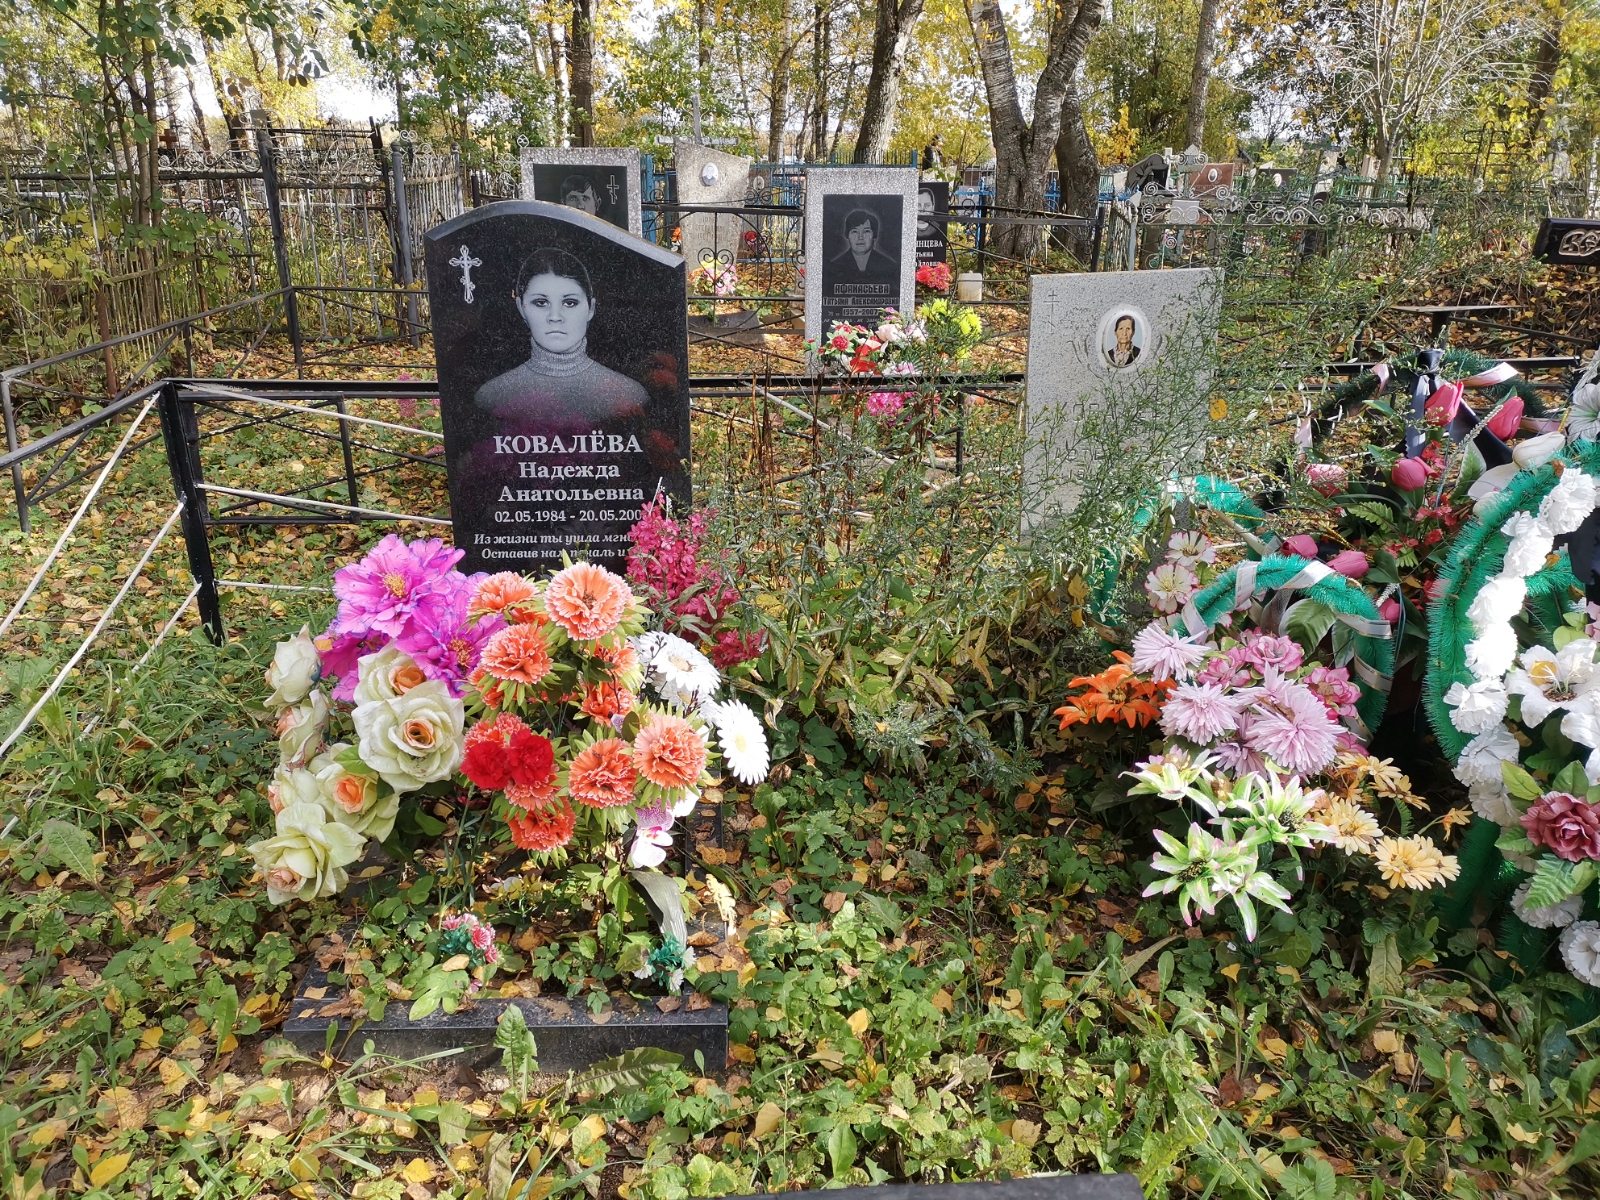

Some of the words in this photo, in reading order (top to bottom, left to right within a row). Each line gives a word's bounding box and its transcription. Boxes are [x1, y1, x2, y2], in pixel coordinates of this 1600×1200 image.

[835, 284, 889, 294] АФАНАСЬЕВА
[843, 308, 878, 316] 1957-2007
[493, 430, 643, 454] КОВАЛЁВА
[518, 462, 620, 480] Надежда
[498, 486, 645, 502] Анатольевна
[494, 511, 567, 522] 02.05.1984
[579, 510, 642, 522] 20.05.200
[473, 534, 491, 544] Из
[493, 535, 538, 544] жизни
[540, 535, 563, 544] ты
[565, 534, 600, 546] ушла
[481, 548, 539, 559] Оставив
[570, 549, 615, 558] паль
